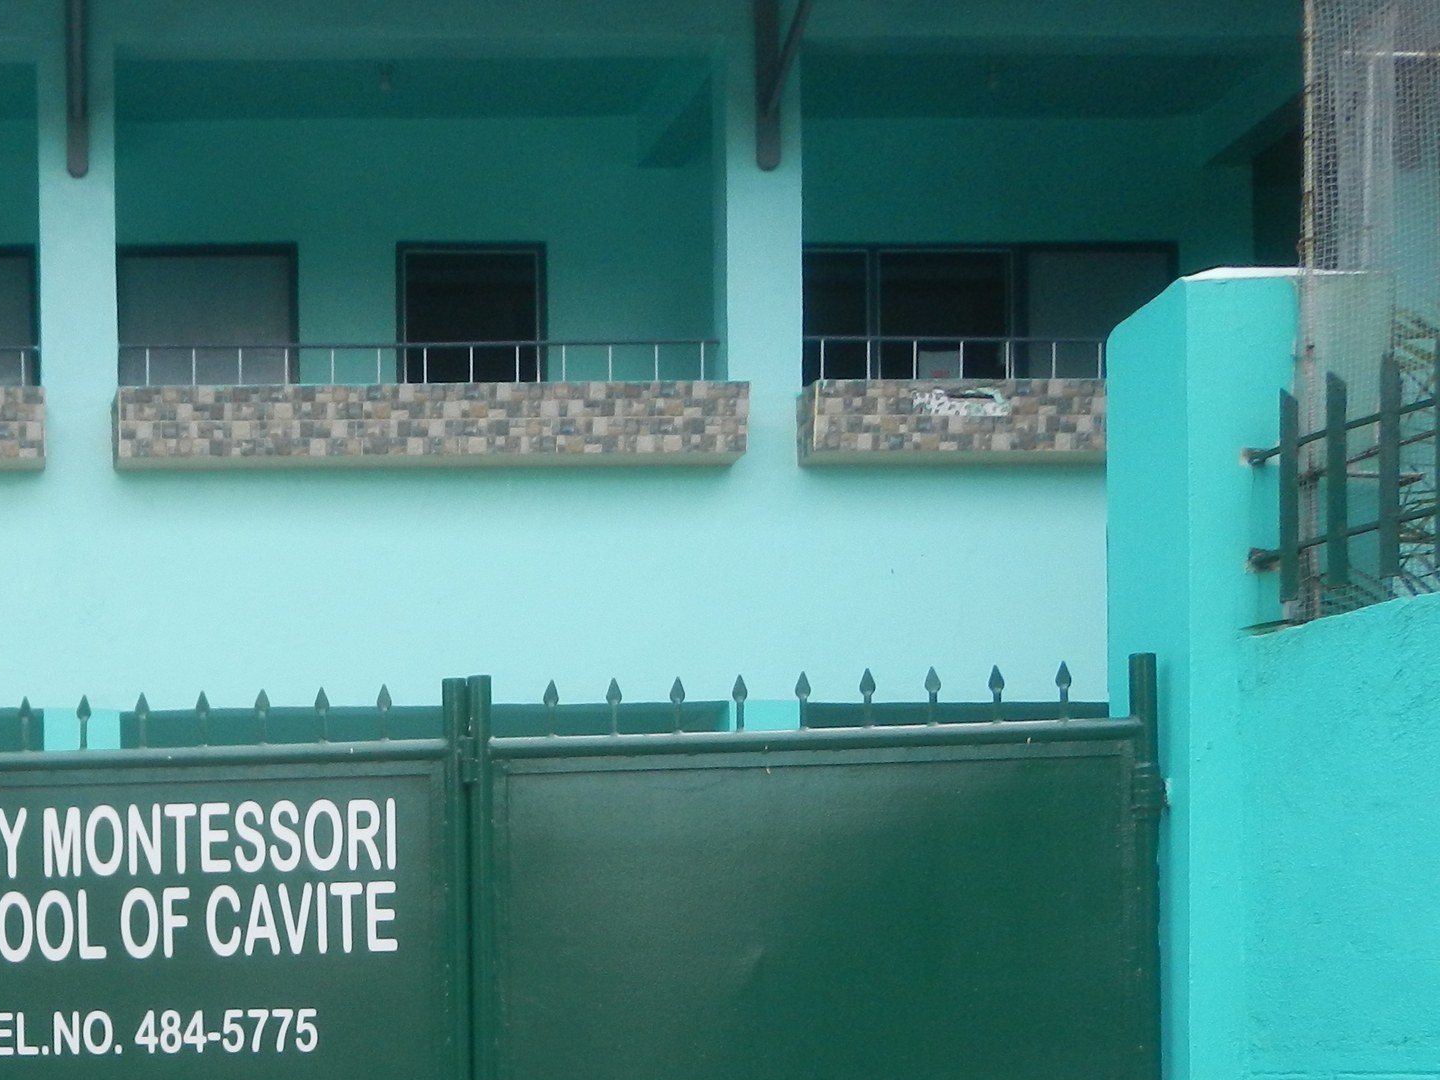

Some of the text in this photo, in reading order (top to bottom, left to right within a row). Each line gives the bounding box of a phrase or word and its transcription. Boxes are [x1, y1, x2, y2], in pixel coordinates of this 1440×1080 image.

[43, 798, 398, 879] MONTESSORI
[120, 887, 191, 960] OF
[206, 881, 399, 957] CAVITE
[134, 1008, 319, 1055] 484-5775
